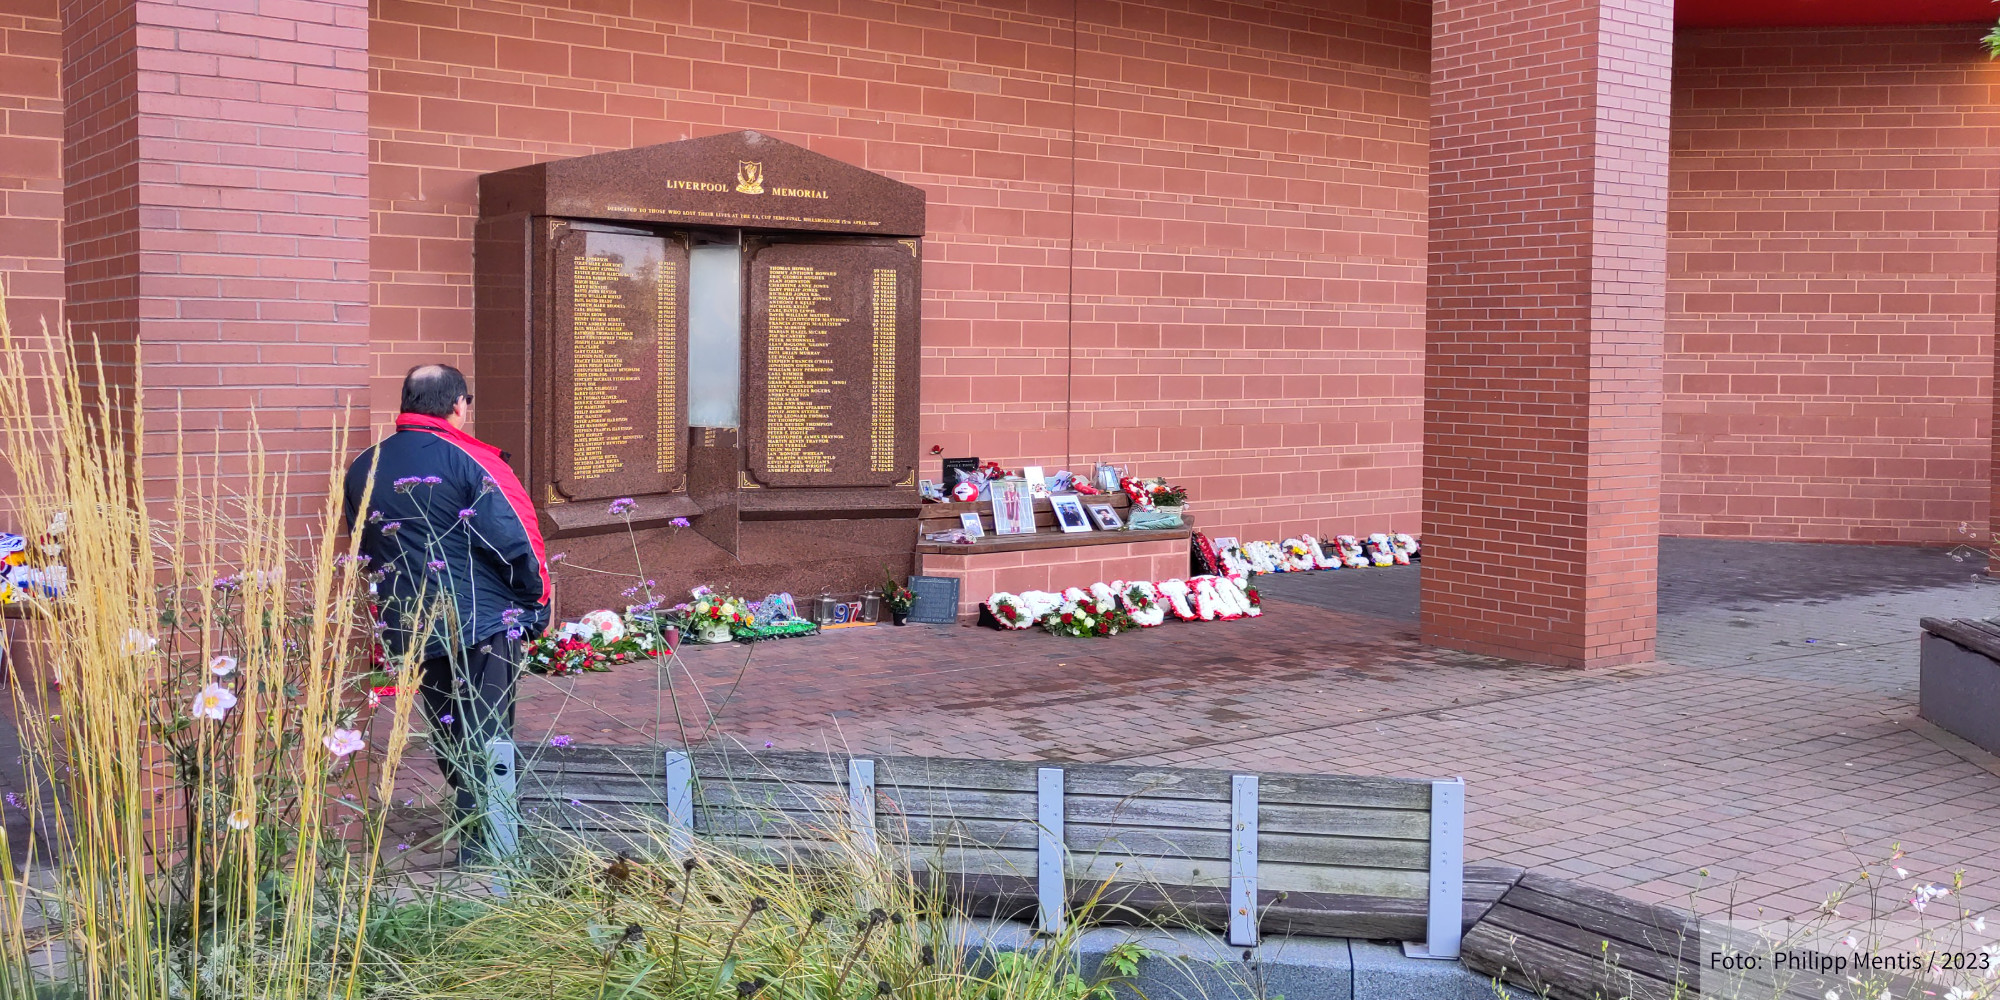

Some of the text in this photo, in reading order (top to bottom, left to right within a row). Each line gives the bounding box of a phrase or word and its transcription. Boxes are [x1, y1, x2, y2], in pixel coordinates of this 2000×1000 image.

[666, 180, 829, 199] LIVERPOOL MEMORIAL
[834, 600, 862, 624] 97
